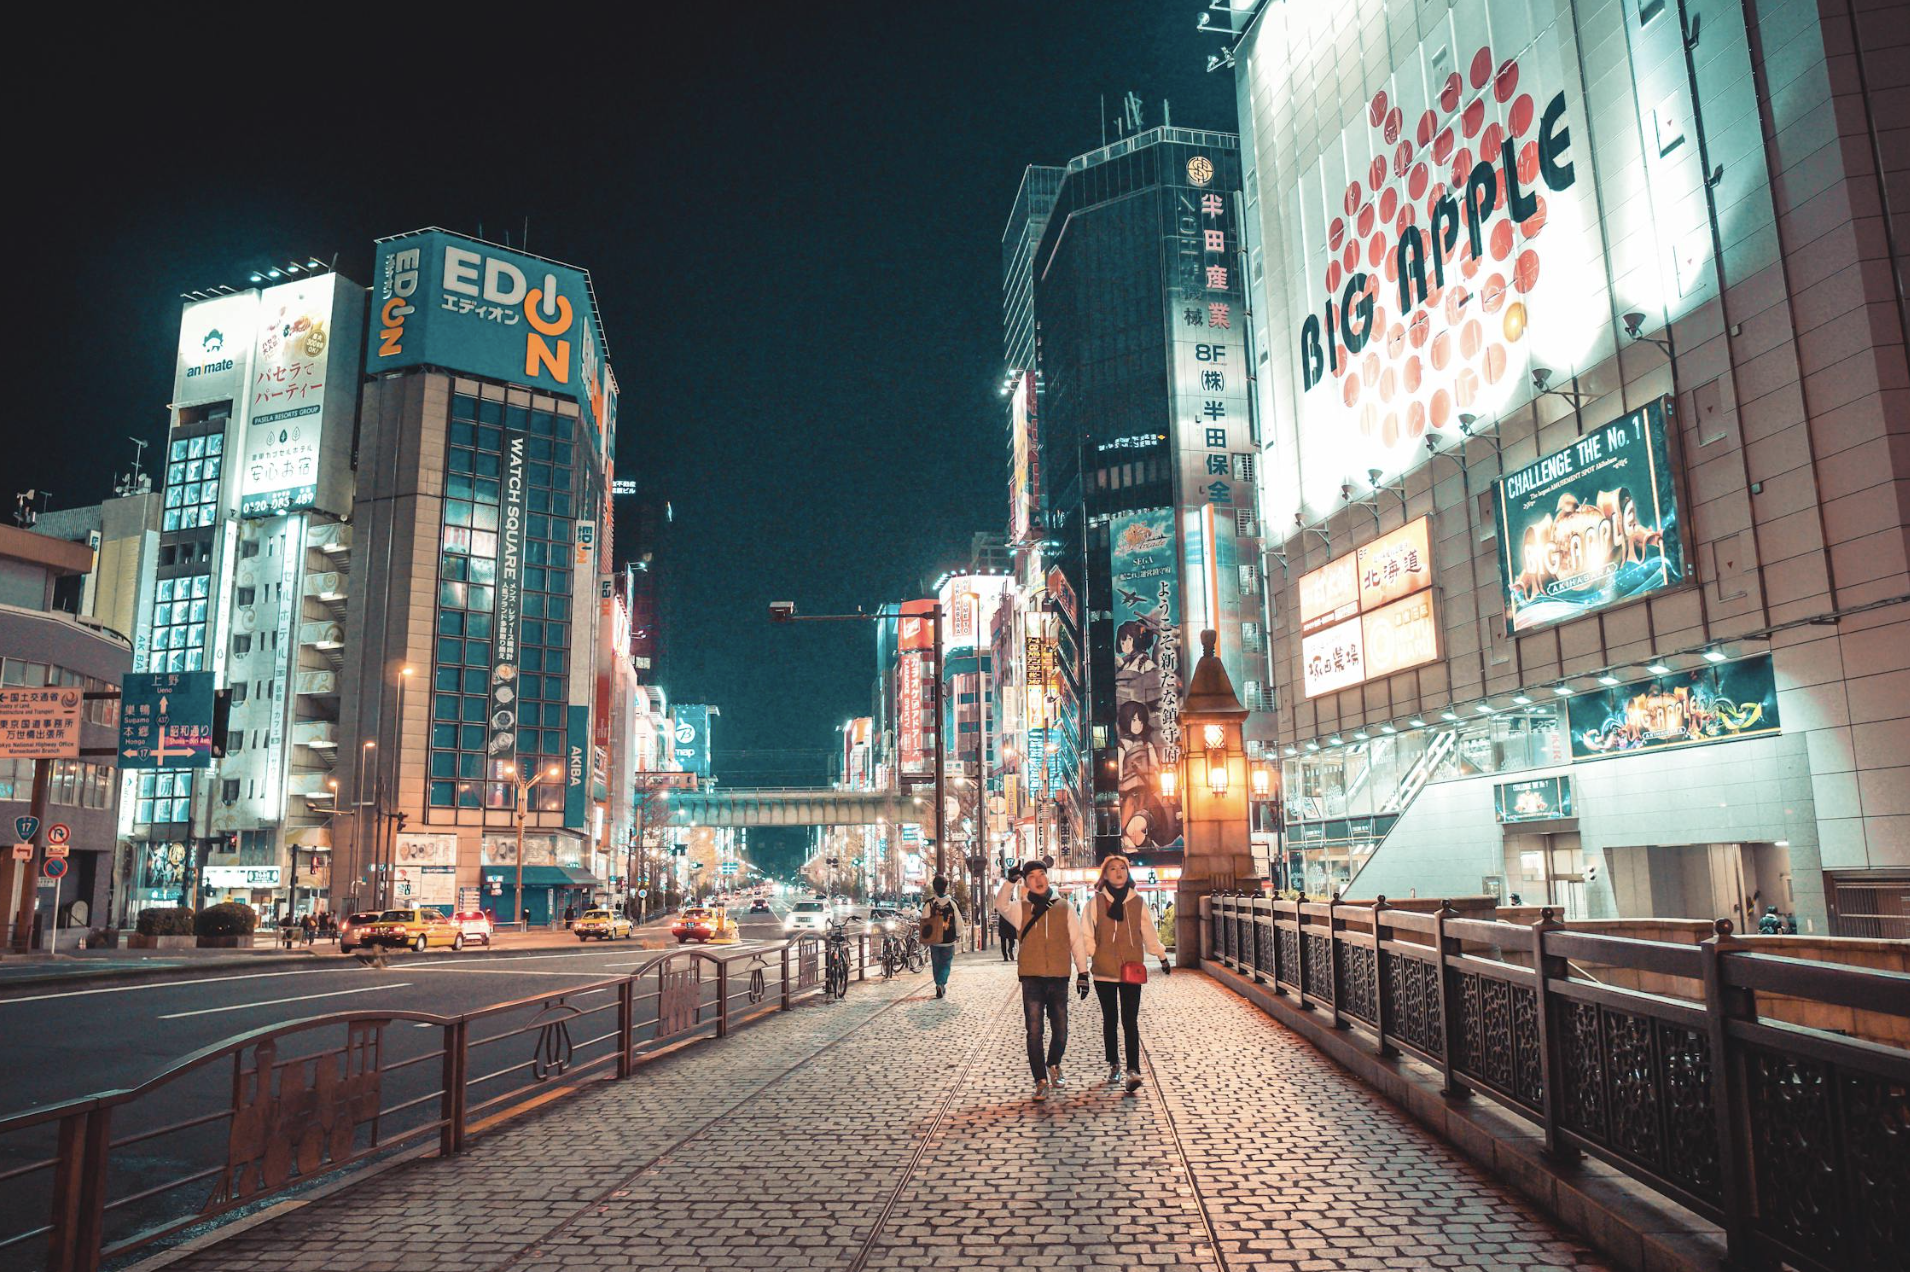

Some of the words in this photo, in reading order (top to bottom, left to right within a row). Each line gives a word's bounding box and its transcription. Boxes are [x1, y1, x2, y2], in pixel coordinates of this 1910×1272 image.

[1301, 272, 1373, 393] BIG
[1397, 91, 1576, 317] APPLE
[1201, 193, 1231, 330] 半田産業
[442, 294, 519, 325] エディオン
[1195, 343, 1226, 362] 8F
[187, 359, 233, 377] animate
[255, 383, 323, 405] パーティー
[254, 414, 274, 424] PASELA
[299, 407, 319, 415] GROUP
[1508, 449, 1573, 499] CHALLENGE
[1577, 435, 1602, 466] THE
[1607, 427, 1630, 452] No.
[1632, 415, 1641, 439] 1
[508, 438, 523, 503] WATCH
[504, 505, 519, 580] SQUARE
[1133, 556, 1153, 566] SEGA
[1363, 548, 1422, 590] 北海道
[151, 674, 179, 686] 上野
[911, 658, 920, 699] カラオケ
[1158, 581, 1179, 765] ようこそ新たな鎮守府
[10, 693, 58, 702] 国土交通省
[1, 719, 73, 729] 東京国道事務所
[6, 729, 64, 739] 万世橋出張所
[169, 725, 209, 737] 昭和通り
[570, 745, 583, 787] AKIBA
[22, 823, 32, 832] 17
